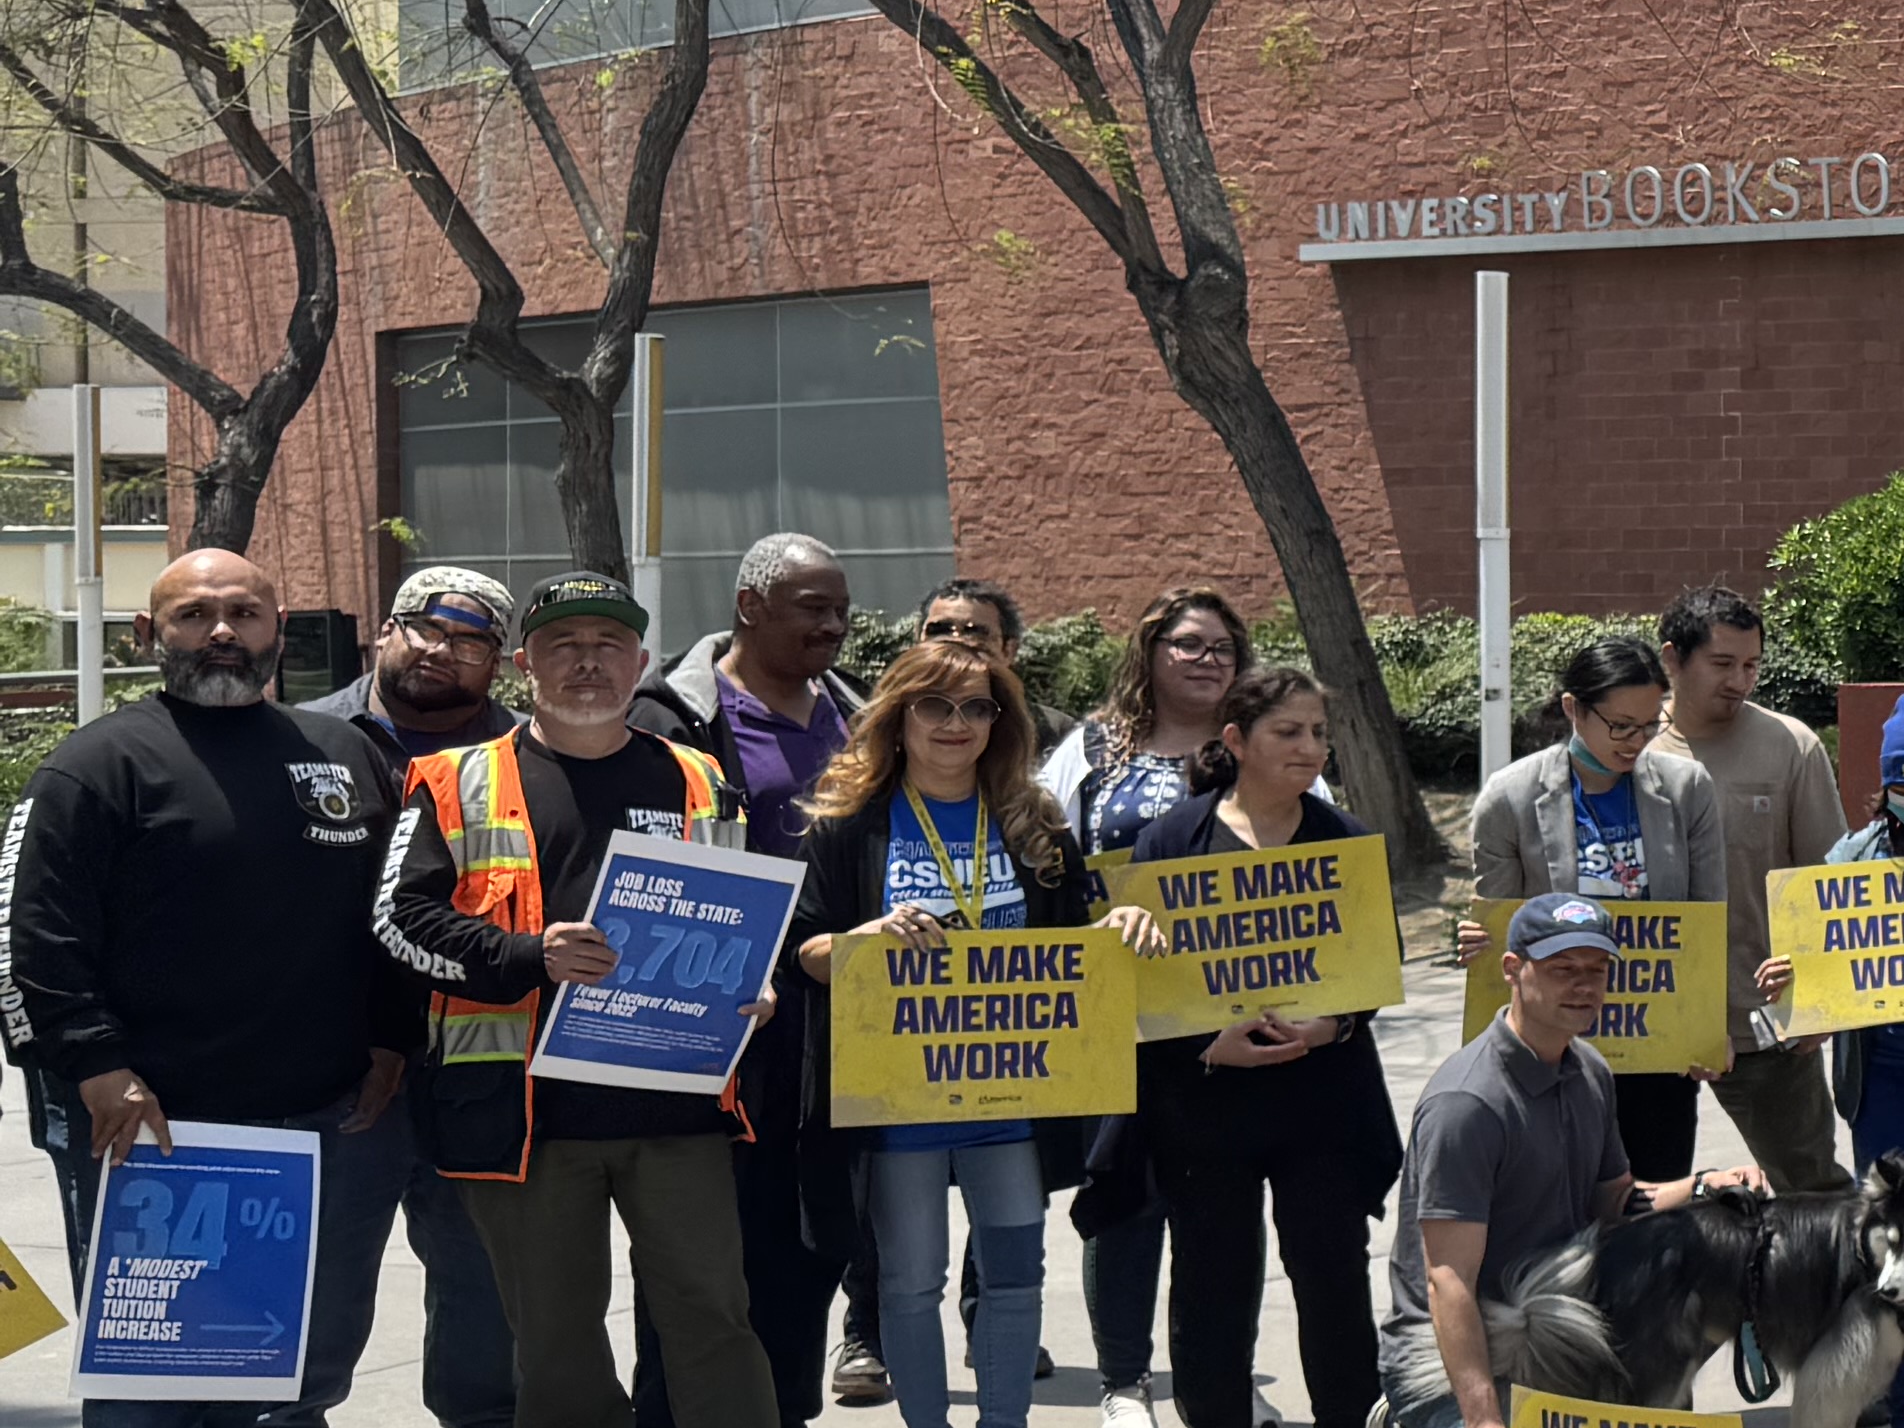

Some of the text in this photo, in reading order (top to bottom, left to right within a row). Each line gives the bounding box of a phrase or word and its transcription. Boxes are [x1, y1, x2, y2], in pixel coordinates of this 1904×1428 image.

[1317, 192, 1568, 242] UNIVERSITY
[310, 825, 369, 843] THUNDER
[628, 808, 684, 829] TEAMSTE
[614, 871, 684, 897] JOB LOSS
[1157, 870, 1219, 911] WE
[1233, 854, 1342, 900] MAKE
[1815, 875, 1872, 911] WE
[609, 889, 744, 925] ACROSS THE STATE:
[1171, 899, 1342, 955] AMERICA
[1615, 916, 1681, 949] AKE
[886, 943, 1085, 986] WE MAKE
[1202, 946, 1321, 996] WORK
[893, 992, 1079, 1035] AMERICA
[923, 1041, 1049, 1083] WORK
[113, 1179, 295, 1270] 34%
[107, 1256, 120, 1277] A
[104, 1279, 181, 1300] STUDENT
[102, 1298, 168, 1320] TUITION
[97, 1319, 183, 1341] INCREASE
